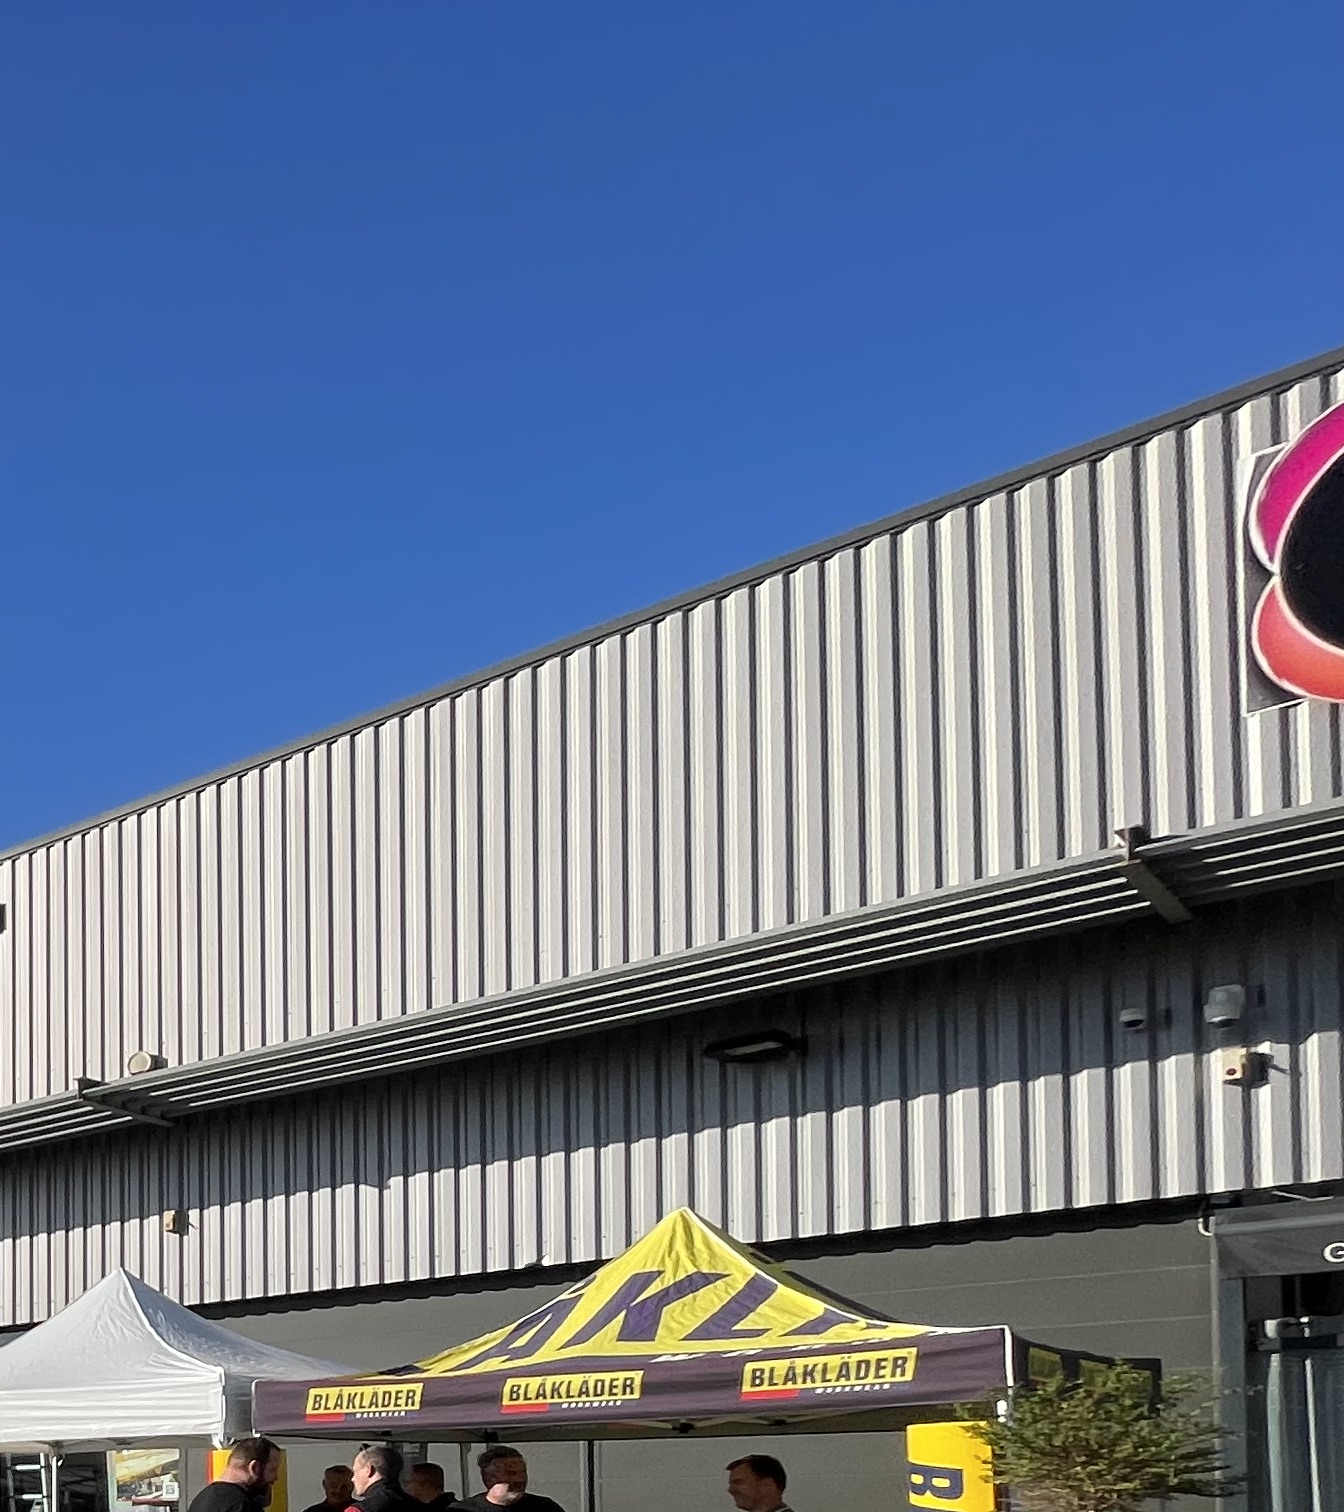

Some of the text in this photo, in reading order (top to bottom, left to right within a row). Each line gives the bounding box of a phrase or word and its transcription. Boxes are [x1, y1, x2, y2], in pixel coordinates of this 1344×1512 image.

[749, 1355, 909, 1388] BLÅKLÄDER
[311, 1386, 417, 1411] BLÅKLÄDER
[507, 1375, 636, 1402] BLÅKLÄDER
